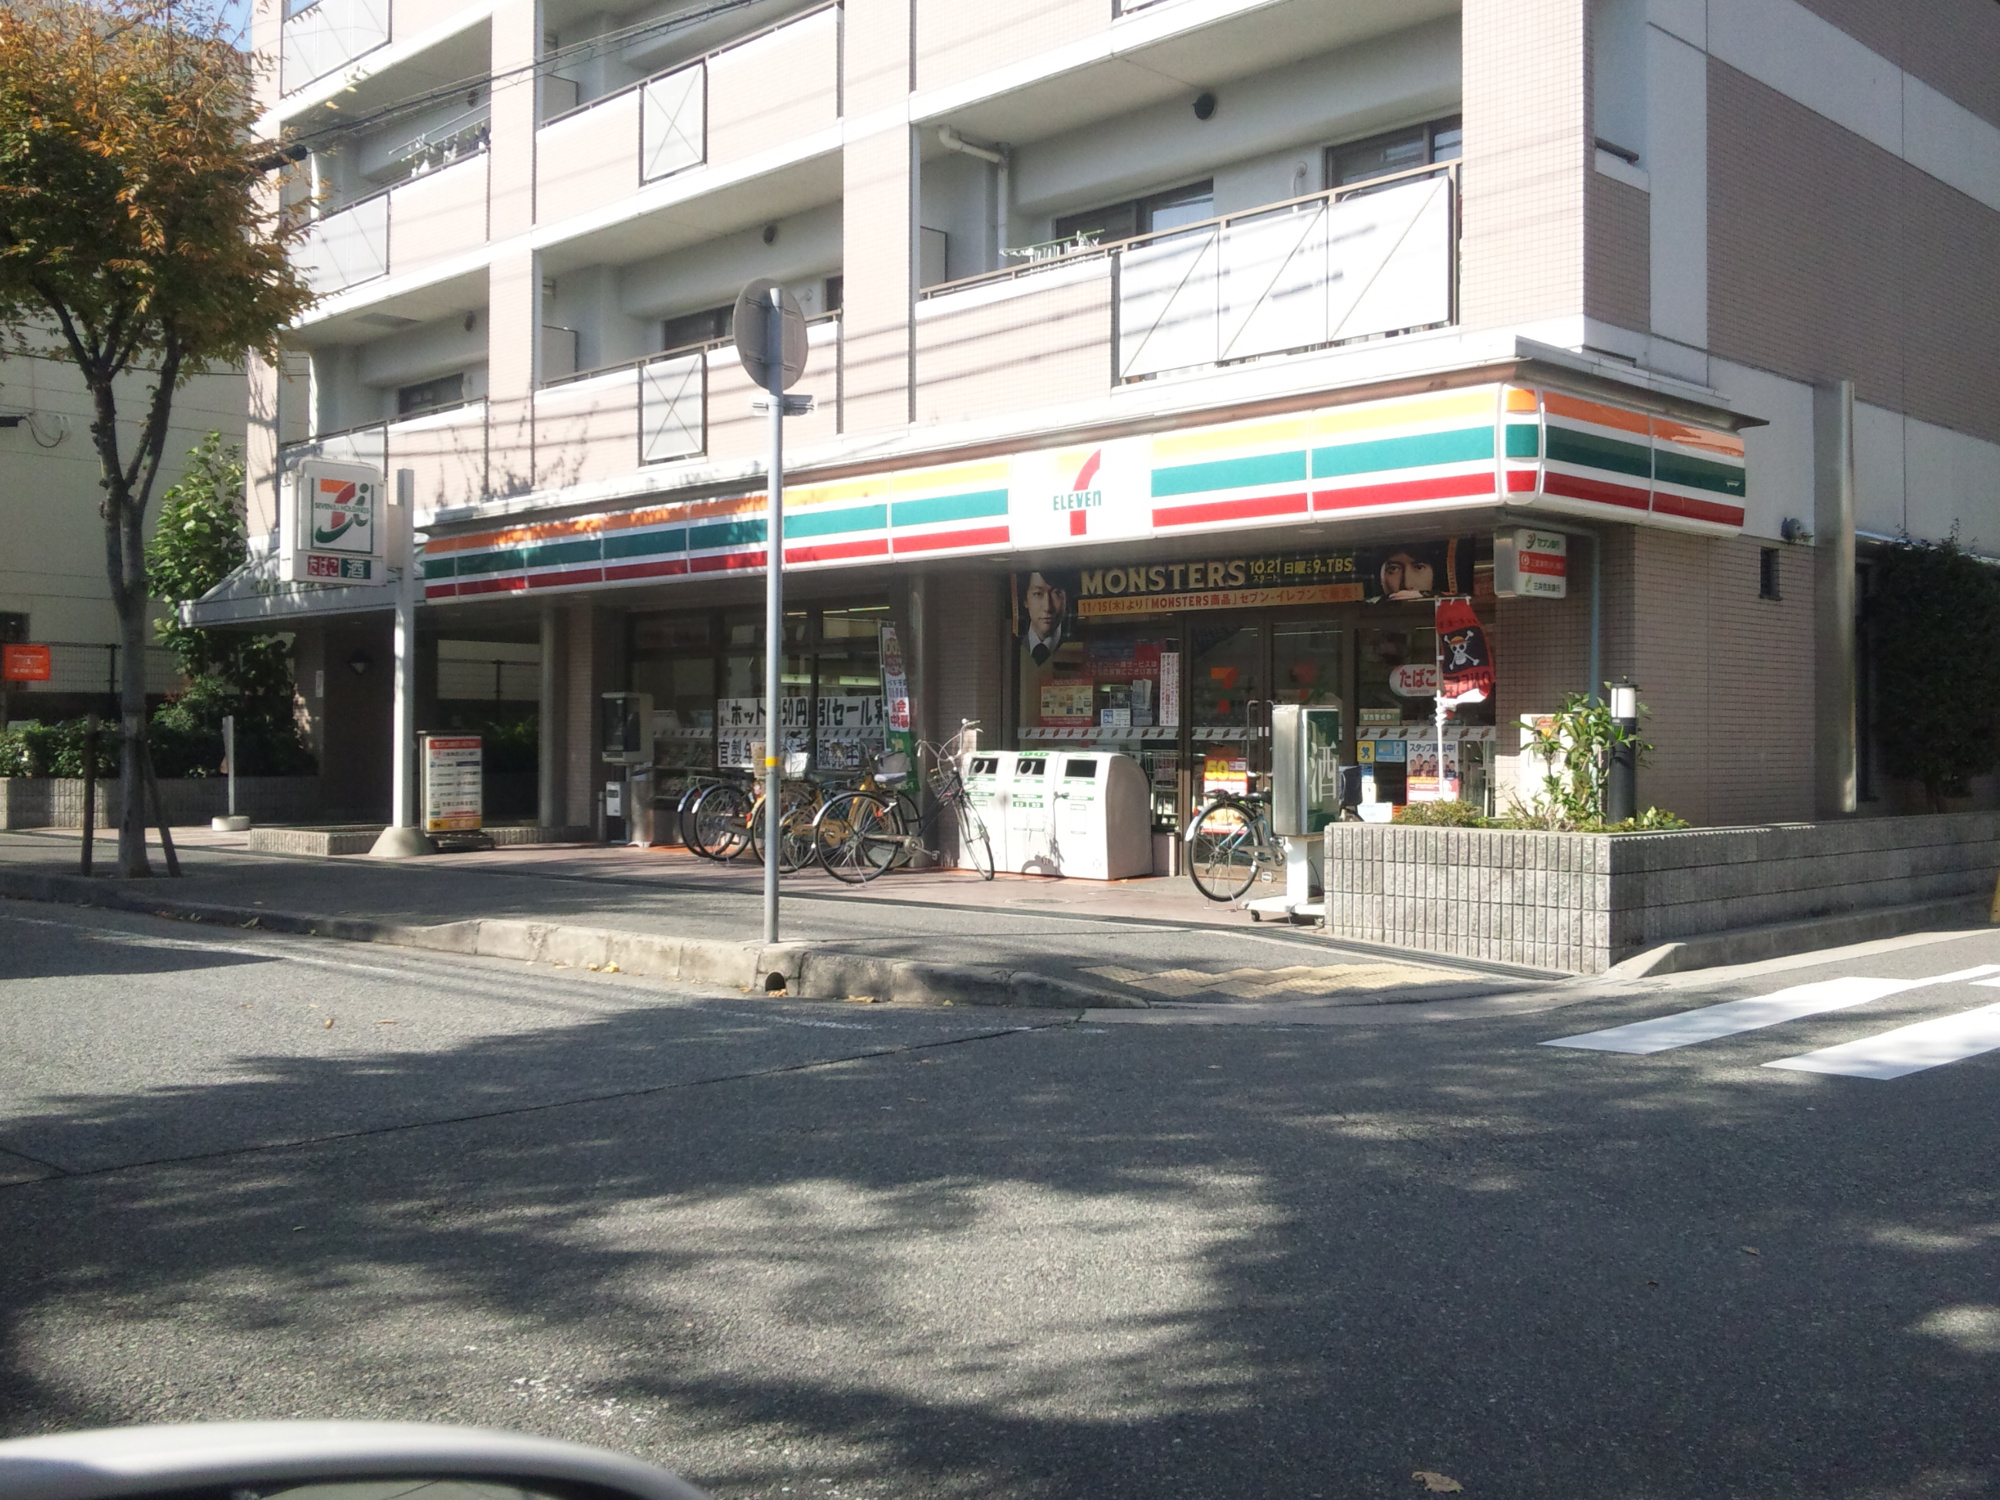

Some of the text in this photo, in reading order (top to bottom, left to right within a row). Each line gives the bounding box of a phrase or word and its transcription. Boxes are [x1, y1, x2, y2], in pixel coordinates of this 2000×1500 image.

[308, 557, 365, 578] たばこ 酒
[1080, 560, 1246, 596] MONSTERS
[1249, 559, 1281, 576] 10.21
[1400, 669, 1437, 688] たばこ
[1309, 741, 1336, 803] 酒
